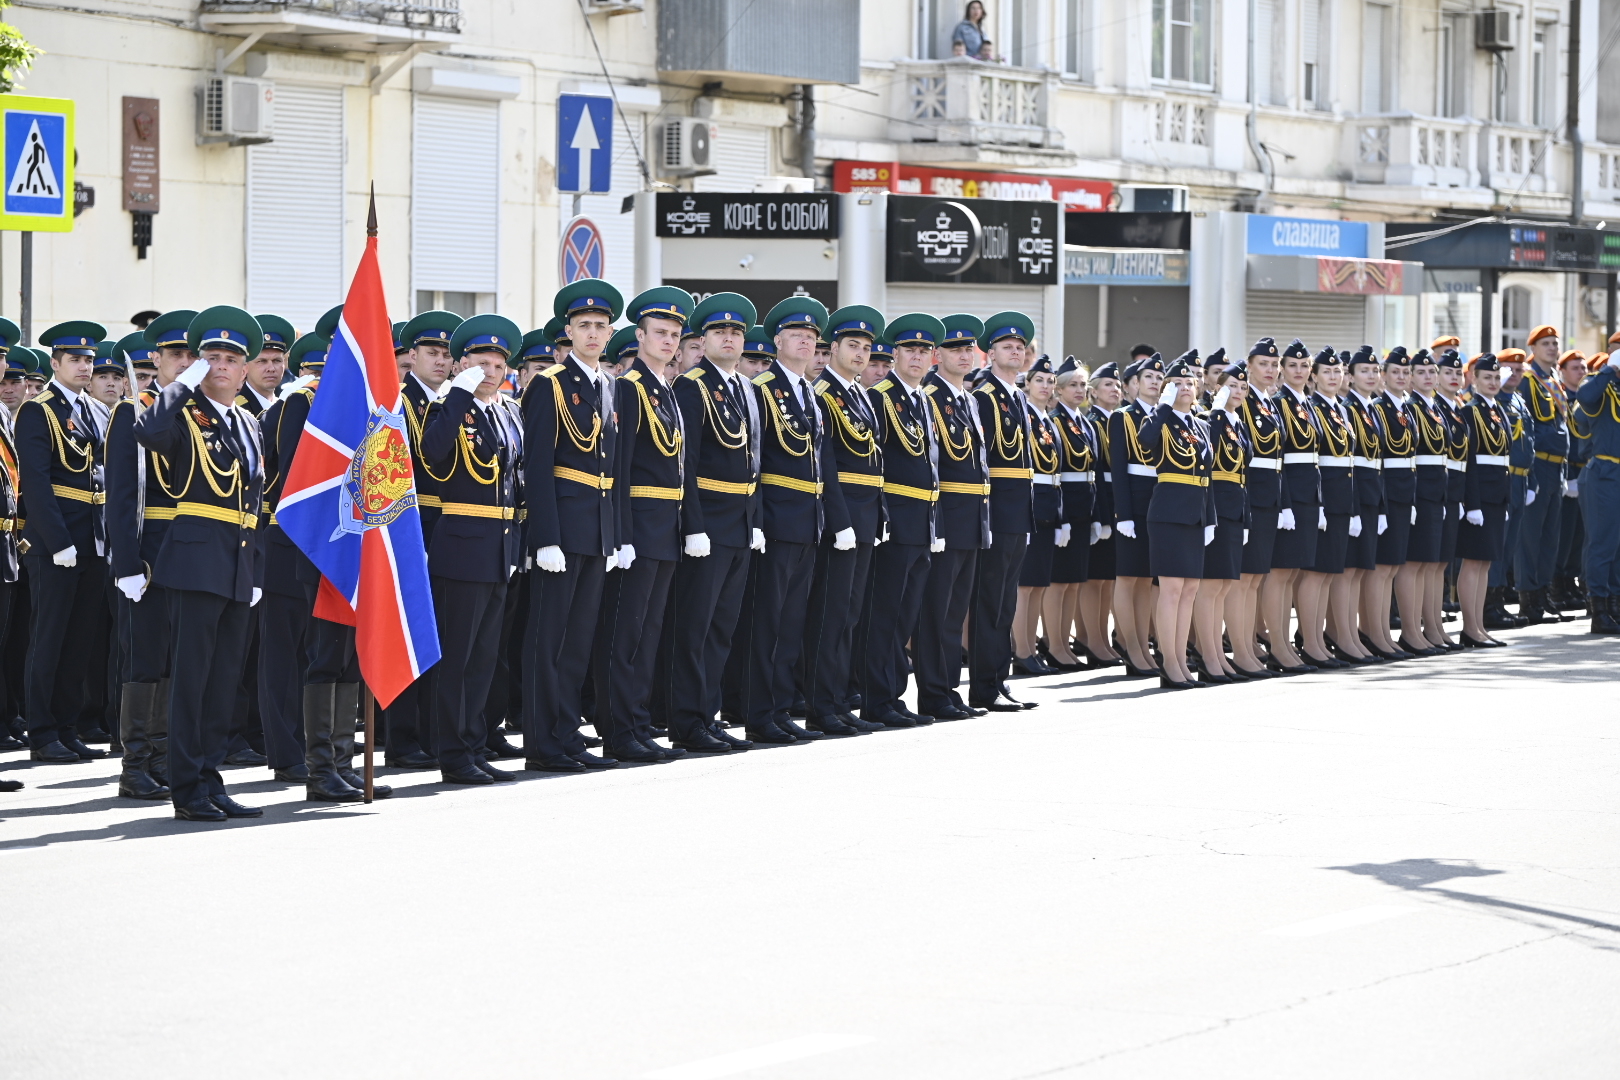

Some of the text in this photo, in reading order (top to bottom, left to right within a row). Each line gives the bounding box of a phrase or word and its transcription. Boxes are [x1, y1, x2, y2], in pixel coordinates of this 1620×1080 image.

[850, 167, 877, 181] 585
[666, 211, 711, 223] КОФЕ
[723, 198, 829, 231] КОФЕ С СОБОЙ
[666, 223, 711, 235] ТУТ
[916, 230, 969, 244] КОФЕ
[916, 243, 969, 256] ТУТ
[1017, 237, 1053, 255] КОФЕ
[1017, 257, 1053, 275] ТУТ
[1112, 253, 1165, 276] ЛЕНИНА
[367, 496, 414, 524] БЕЗОПАСНОСТИ
